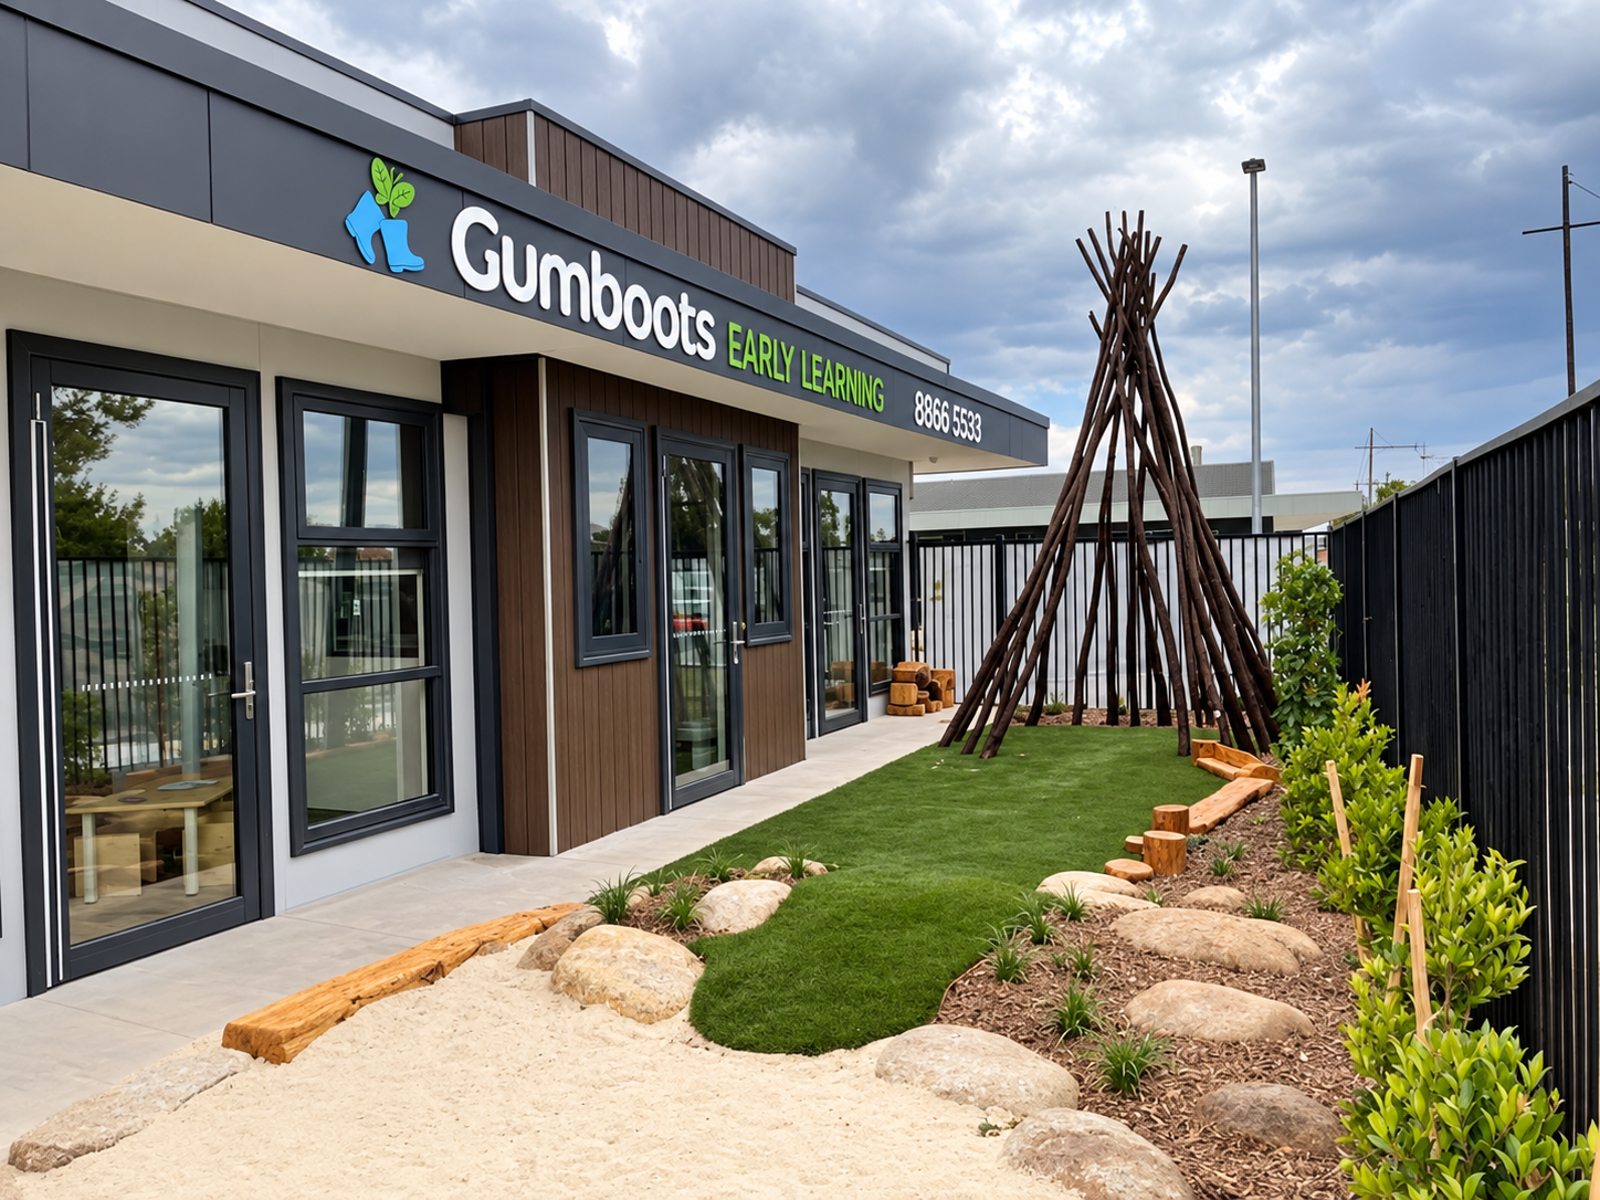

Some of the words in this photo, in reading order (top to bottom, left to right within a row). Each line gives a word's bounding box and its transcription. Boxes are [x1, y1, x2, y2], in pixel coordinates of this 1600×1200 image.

[451, 206, 716, 361] Gumboots
[728, 321, 794, 383] EARLY
[801, 350, 884, 412] LEARNING
[914, 391, 949, 434] 8866
[952, 405, 981, 443] 5533
